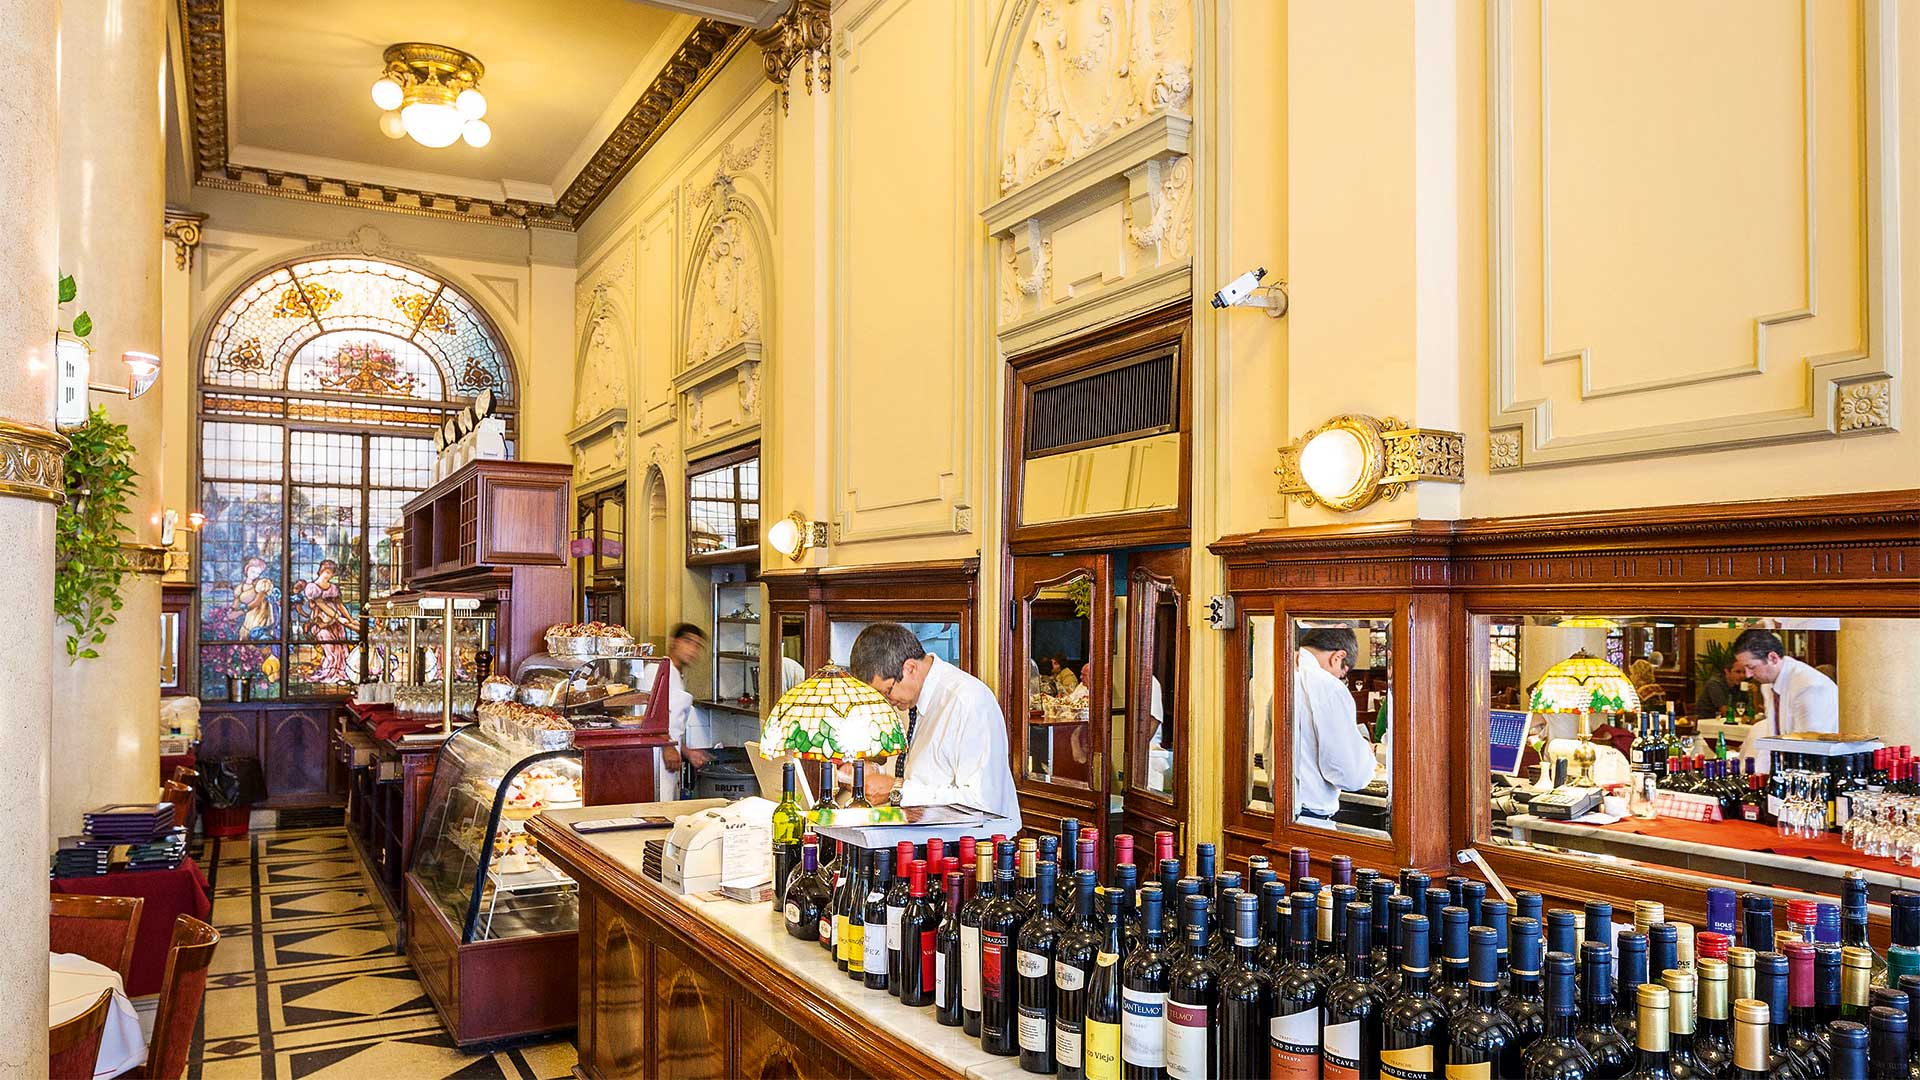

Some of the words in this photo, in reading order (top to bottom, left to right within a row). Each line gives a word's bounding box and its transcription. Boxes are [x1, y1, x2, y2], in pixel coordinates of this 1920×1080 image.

[715, 784, 745, 792] BRUTE
[1094, 1052, 1115, 1063] Viejo
[1335, 1058, 1354, 1067] CAVE
[1407, 1072, 1427, 1080] CAVE
